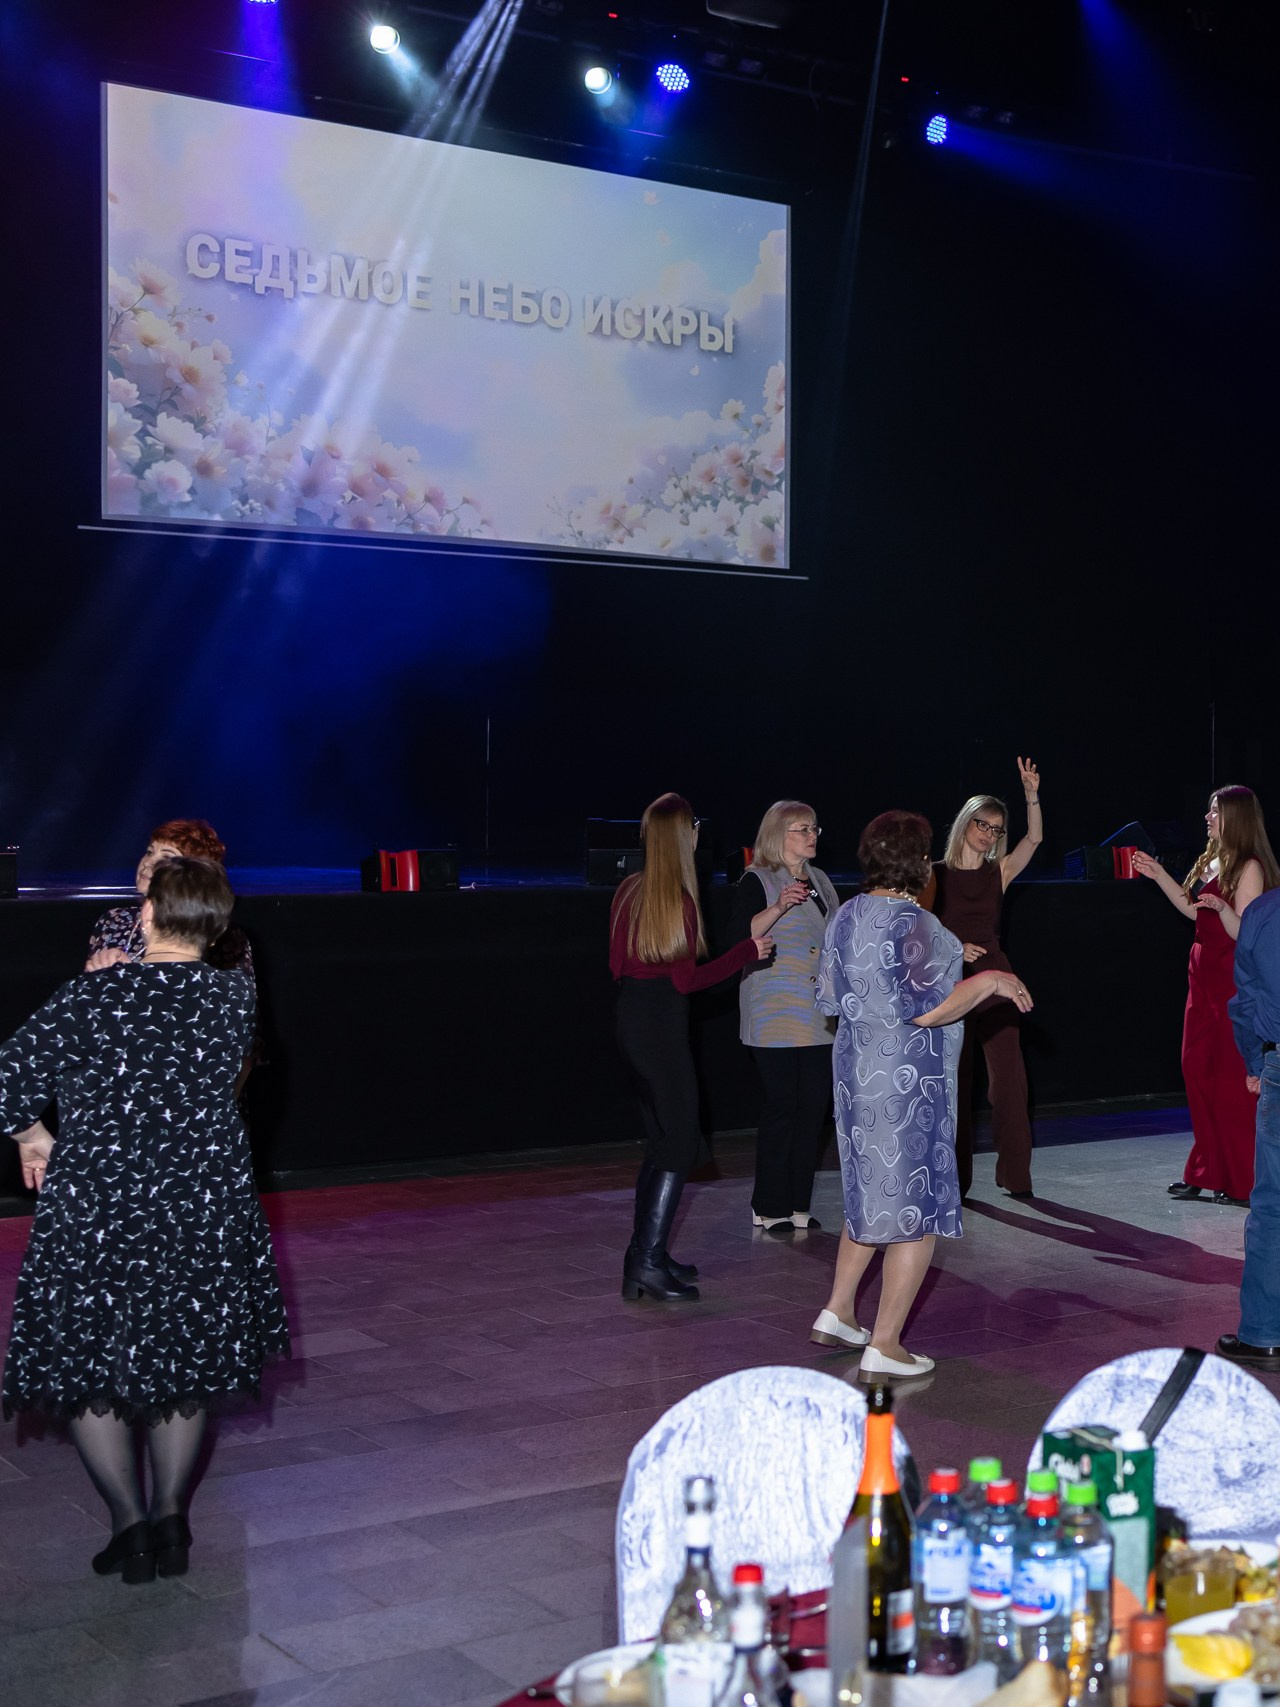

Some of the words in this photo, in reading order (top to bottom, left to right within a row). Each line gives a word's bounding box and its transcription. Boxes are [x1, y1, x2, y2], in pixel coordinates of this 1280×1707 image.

[185, 232, 434, 310] СЕДЬМОЕ
[450, 278, 572, 329] НЕБО
[585, 294, 735, 354] ИСКРЫ
